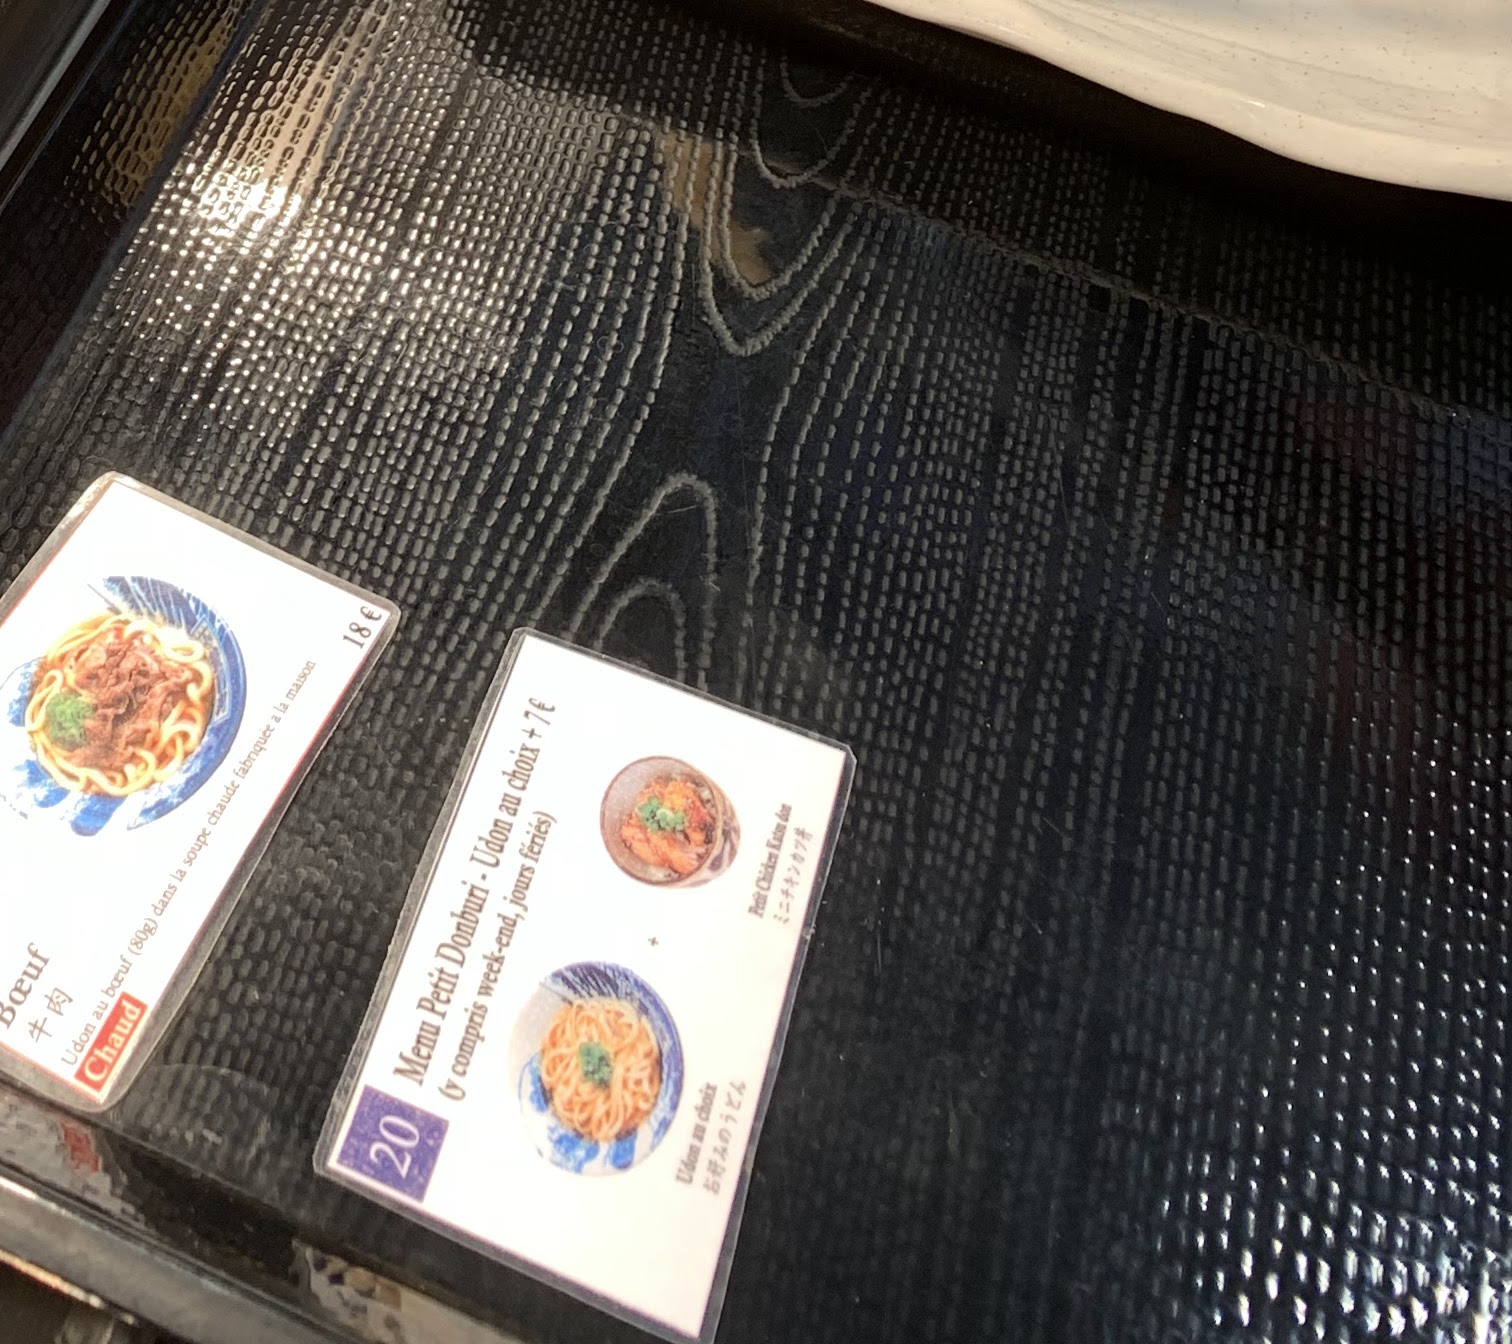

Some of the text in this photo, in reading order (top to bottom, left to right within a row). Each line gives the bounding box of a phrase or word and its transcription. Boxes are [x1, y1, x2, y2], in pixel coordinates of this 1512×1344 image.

[342, 620, 372, 650] 18
[501, 742, 541, 793] choix
[498, 792, 522, 818] au
[60, 1022, 97, 1066] Udon
[92, 1000, 109, 1021] au
[101, 954, 133, 998] bœuf
[127, 917, 158, 957] (80g)
[150, 881, 178, 918] dans
[169, 866, 187, 884] la
[182, 826, 211, 868] soupe
[207, 777, 240, 827] chaude
[273, 701, 288, 715] la
[285, 658, 317, 703] maison
[469, 818, 513, 869] Udon
[434, 879, 490, 969] Donburi
[438, 810, 558, 1102] (y compris week-end, jours fériés)
[27, 987, 74, 1044] 牛肉
[416, 965, 460, 1021] Petit
[83, 999, 141, 1083] Chaud
[392, 1020, 441, 1087] Menu
[369, 1114, 420, 1180] 20
[675, 1143, 701, 1184] Udon
[695, 1082, 717, 1123] choix
